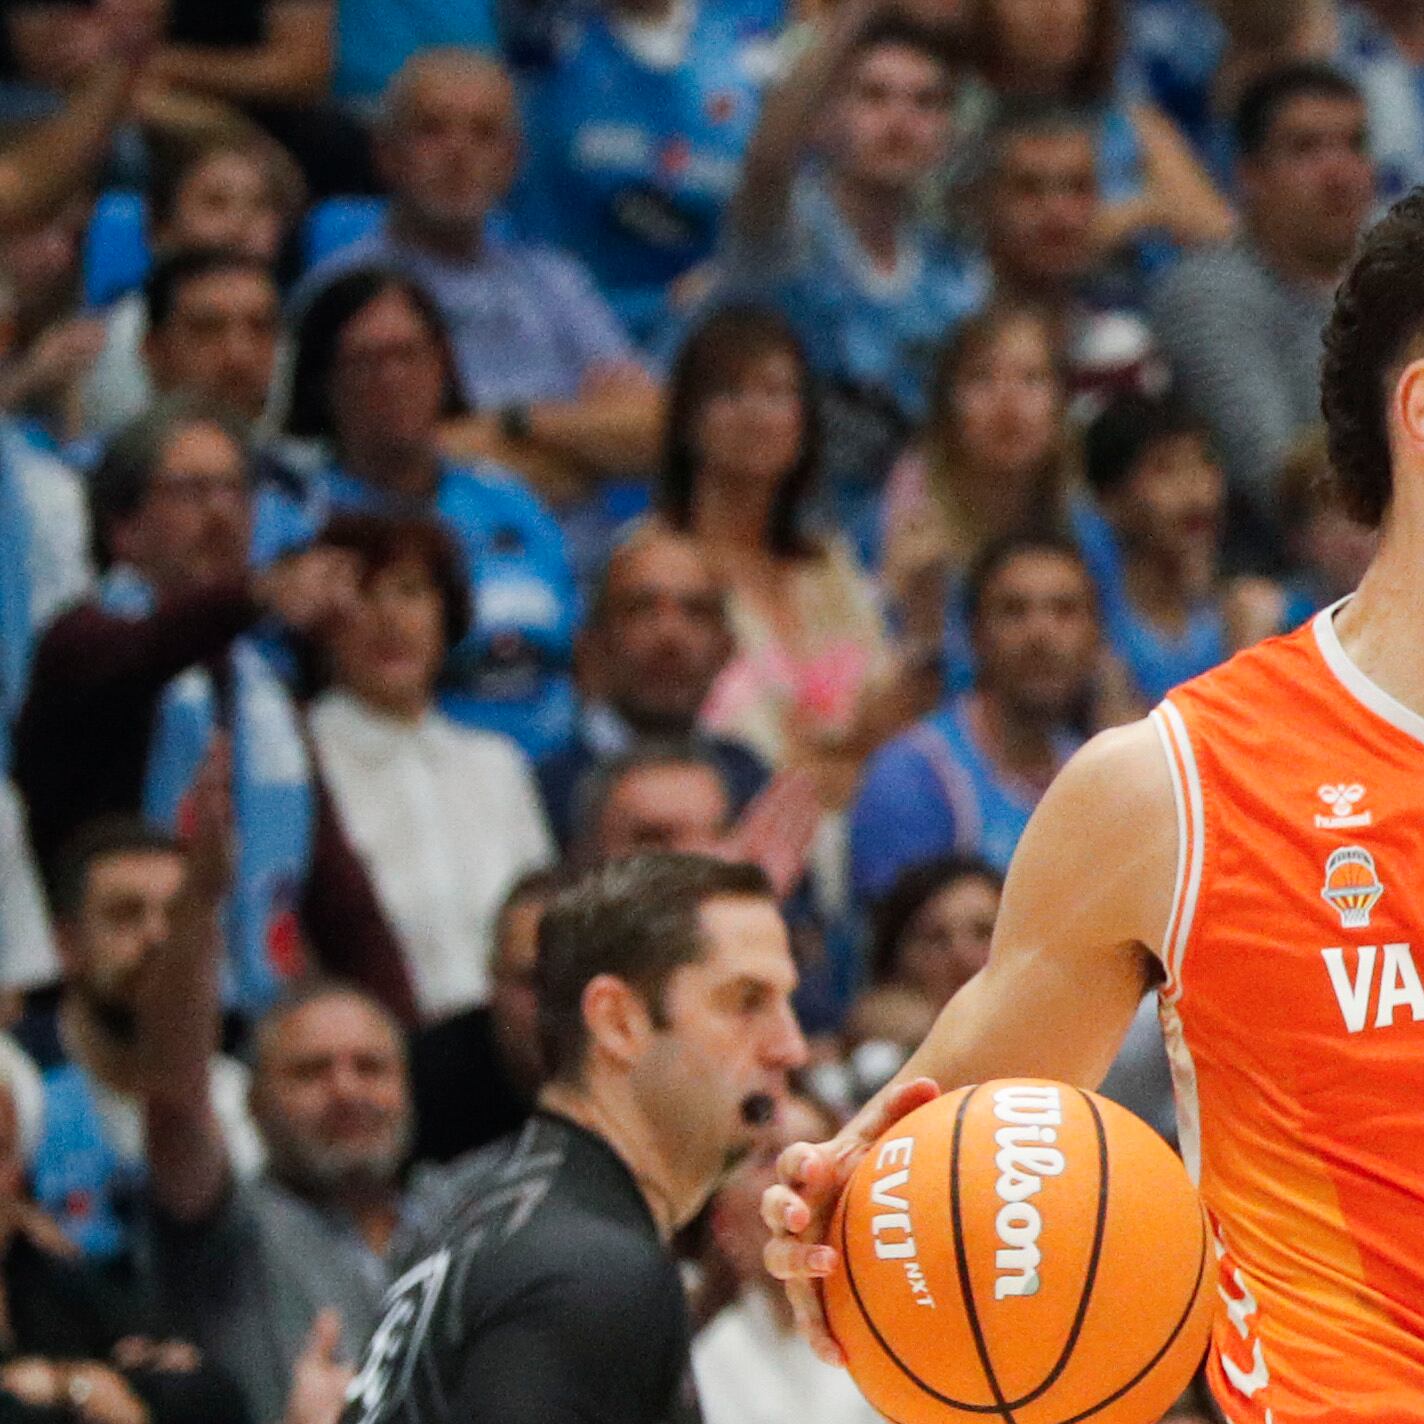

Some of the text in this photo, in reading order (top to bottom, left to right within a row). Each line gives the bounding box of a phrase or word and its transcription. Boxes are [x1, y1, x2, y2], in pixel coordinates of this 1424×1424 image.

[870, 1136, 937, 1310] EVO NXT
[992, 1085, 1066, 1301] Wilson
